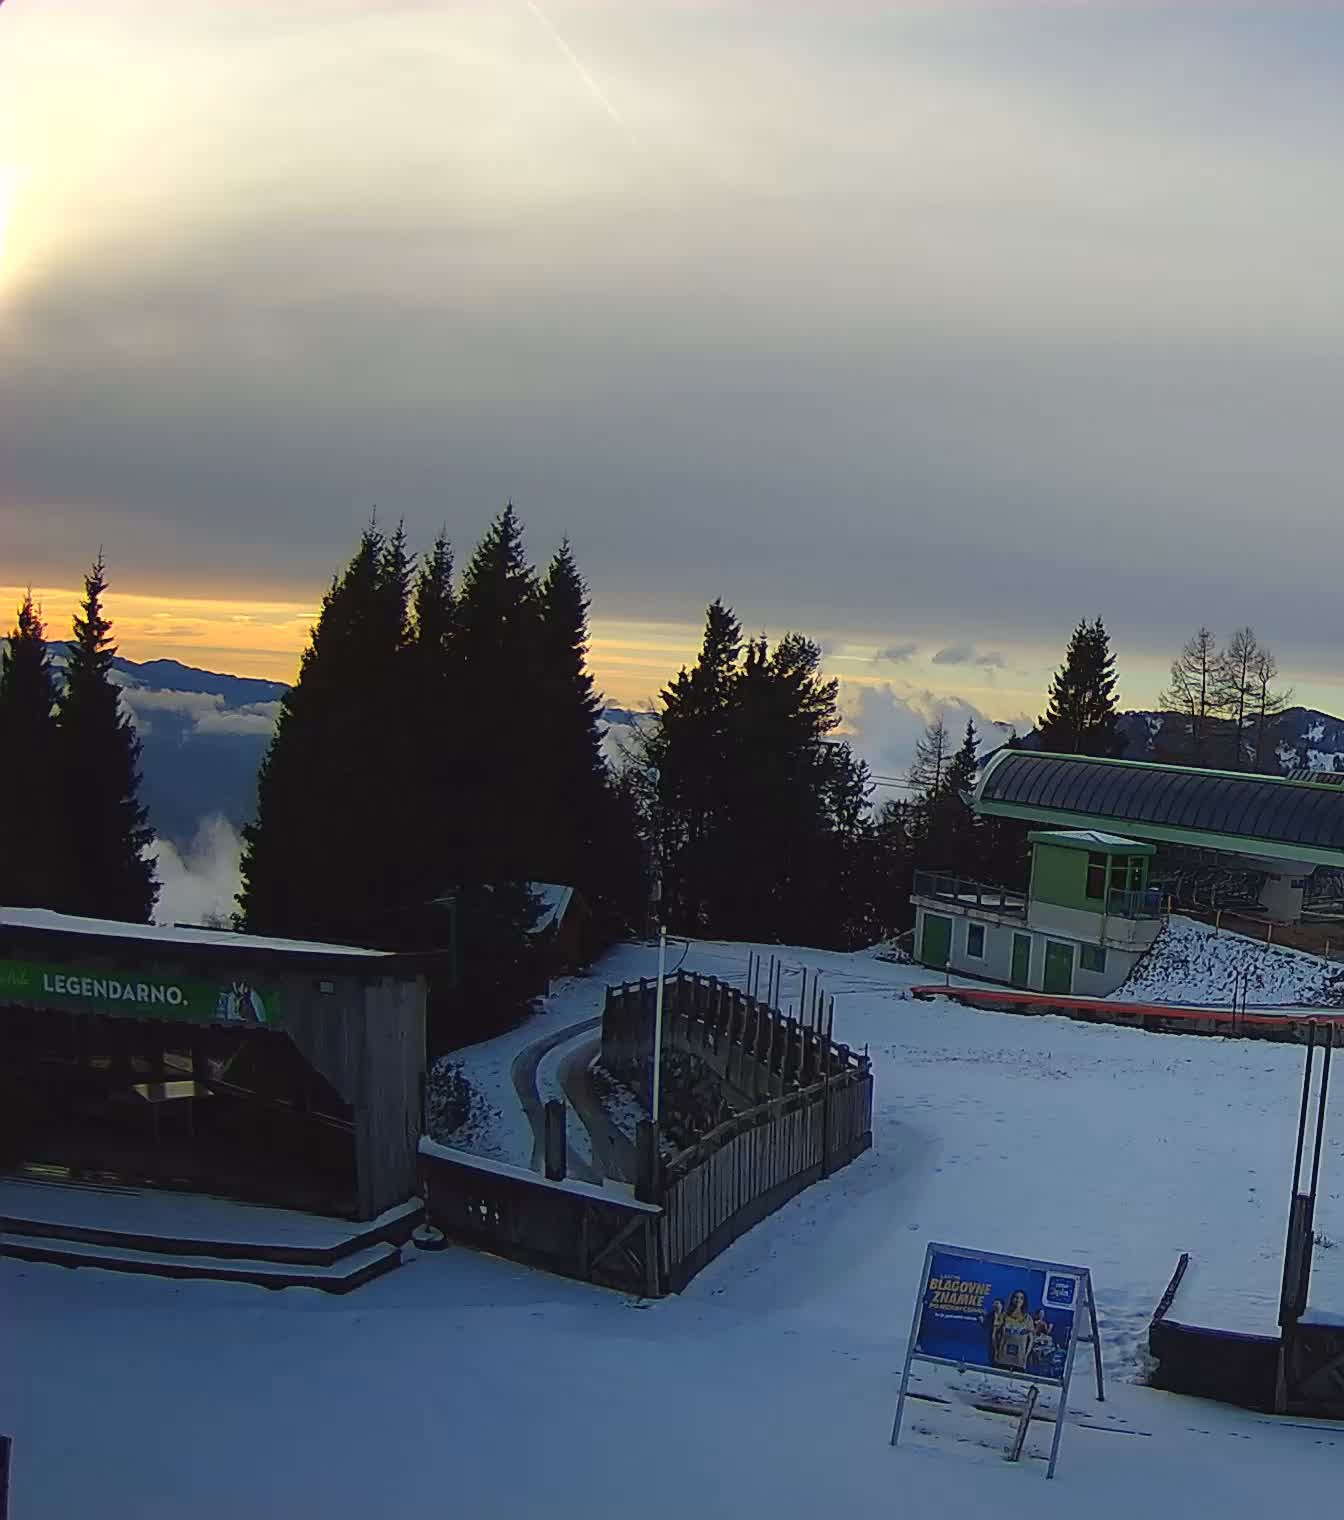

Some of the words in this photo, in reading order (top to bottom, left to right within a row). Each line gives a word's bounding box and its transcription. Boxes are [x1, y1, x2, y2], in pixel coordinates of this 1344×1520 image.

[43, 973, 189, 1007] LEGENDARNO.
[929, 1278, 992, 1296] BLAGOVNE
[932, 1290, 985, 1307] ZNAMKE
